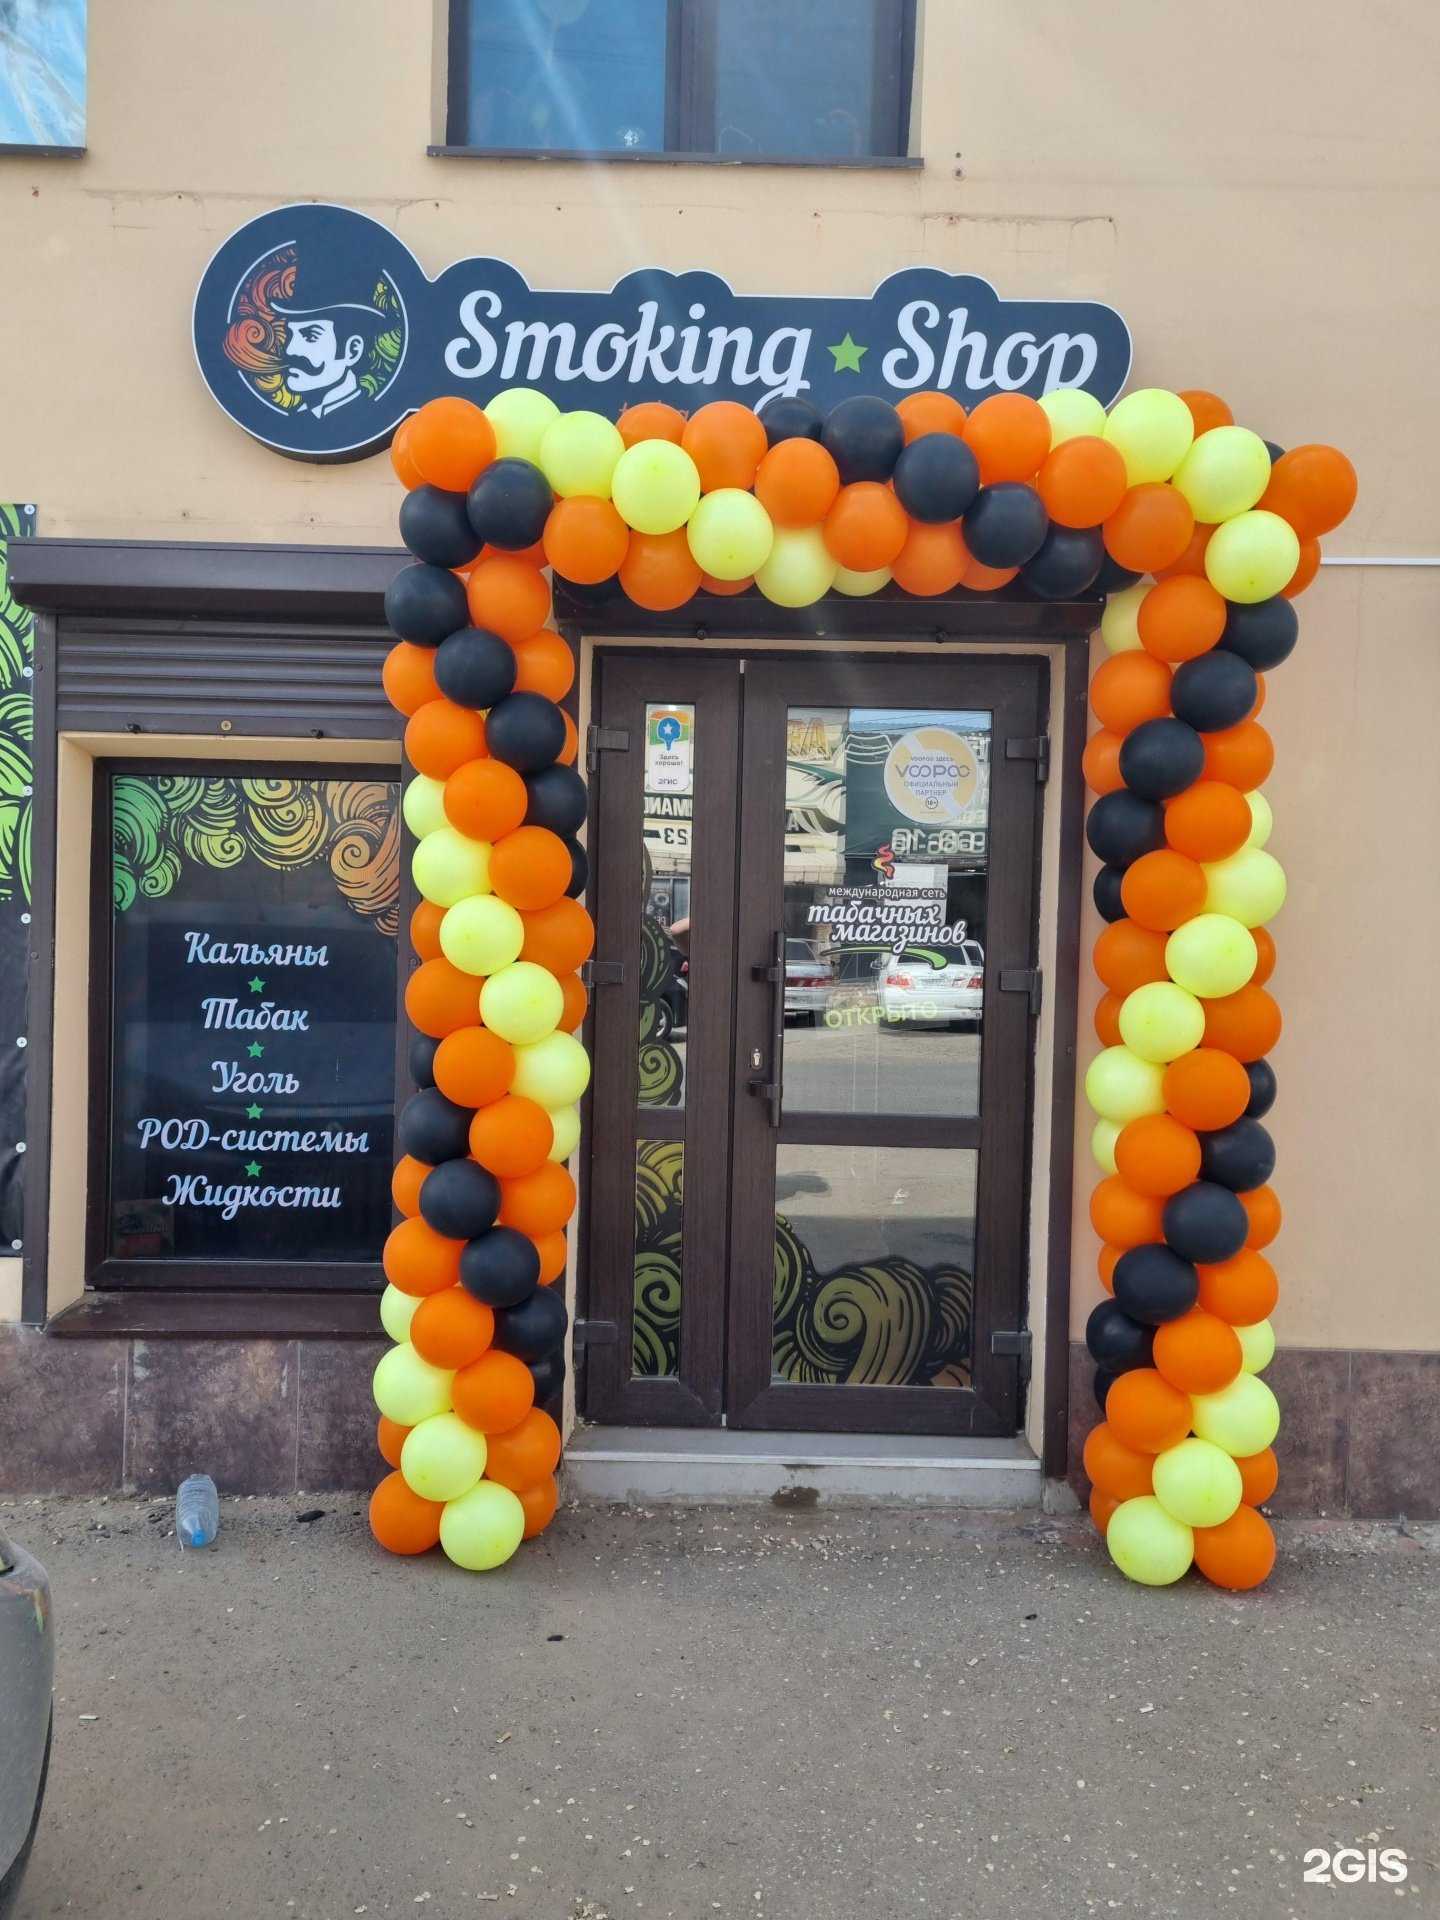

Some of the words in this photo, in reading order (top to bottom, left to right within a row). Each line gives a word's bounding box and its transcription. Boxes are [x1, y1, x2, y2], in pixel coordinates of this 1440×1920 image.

[445, 289, 812, 415] Smoking
[882, 300, 1098, 396] Shop
[895, 764, 970, 778] VOOPOO
[829, 887, 918, 899] международная
[922, 888, 946, 898] сеть
[807, 901, 940, 925] табачных
[184, 931, 329, 966] Кальяны
[831, 921, 966, 954] магазинов
[201, 997, 310, 1031] Табак
[825, 1001, 938, 1028] ОТКРЫТО
[211, 1060, 300, 1094] Уголь
[137, 1118, 370, 1153] POD-системы
[162, 1174, 342, 1220] Жидкости
